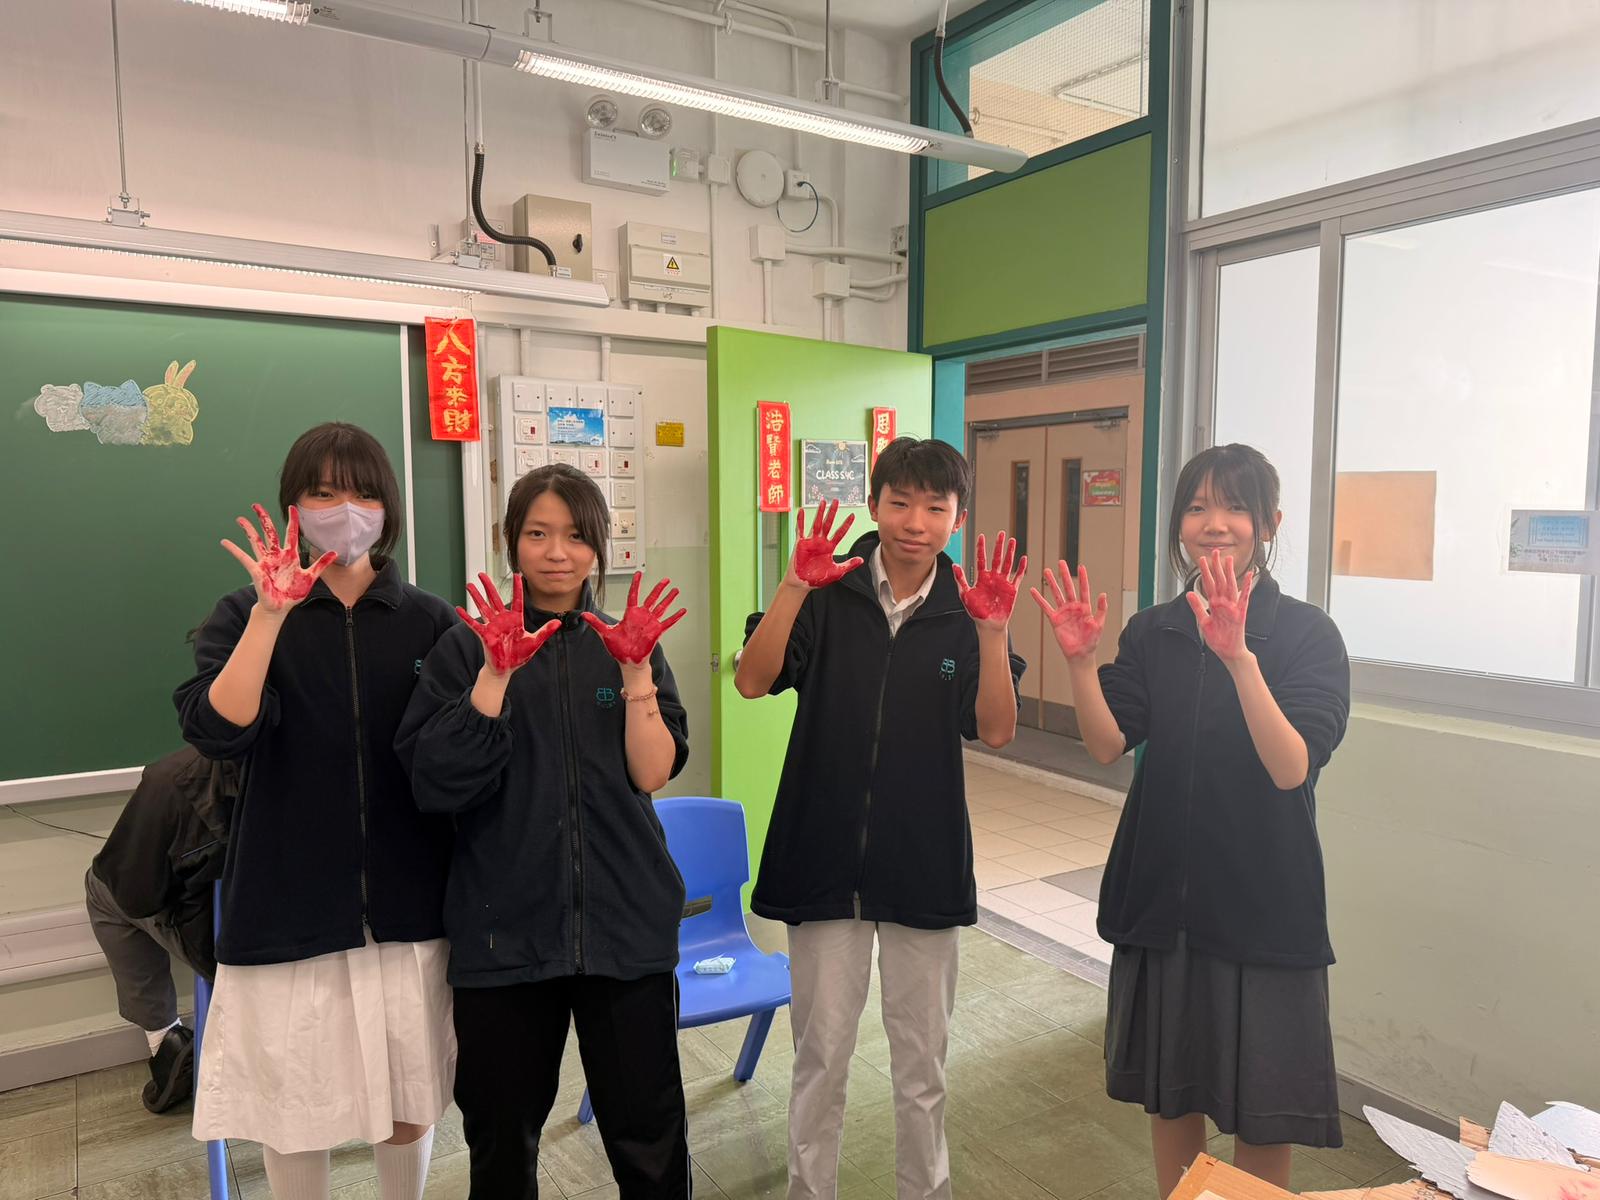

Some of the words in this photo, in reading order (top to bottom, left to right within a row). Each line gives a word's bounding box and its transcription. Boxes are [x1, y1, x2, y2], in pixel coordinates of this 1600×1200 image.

[766, 409, 784, 505] 浩賢老師
[815, 470, 840, 480] CLASS
